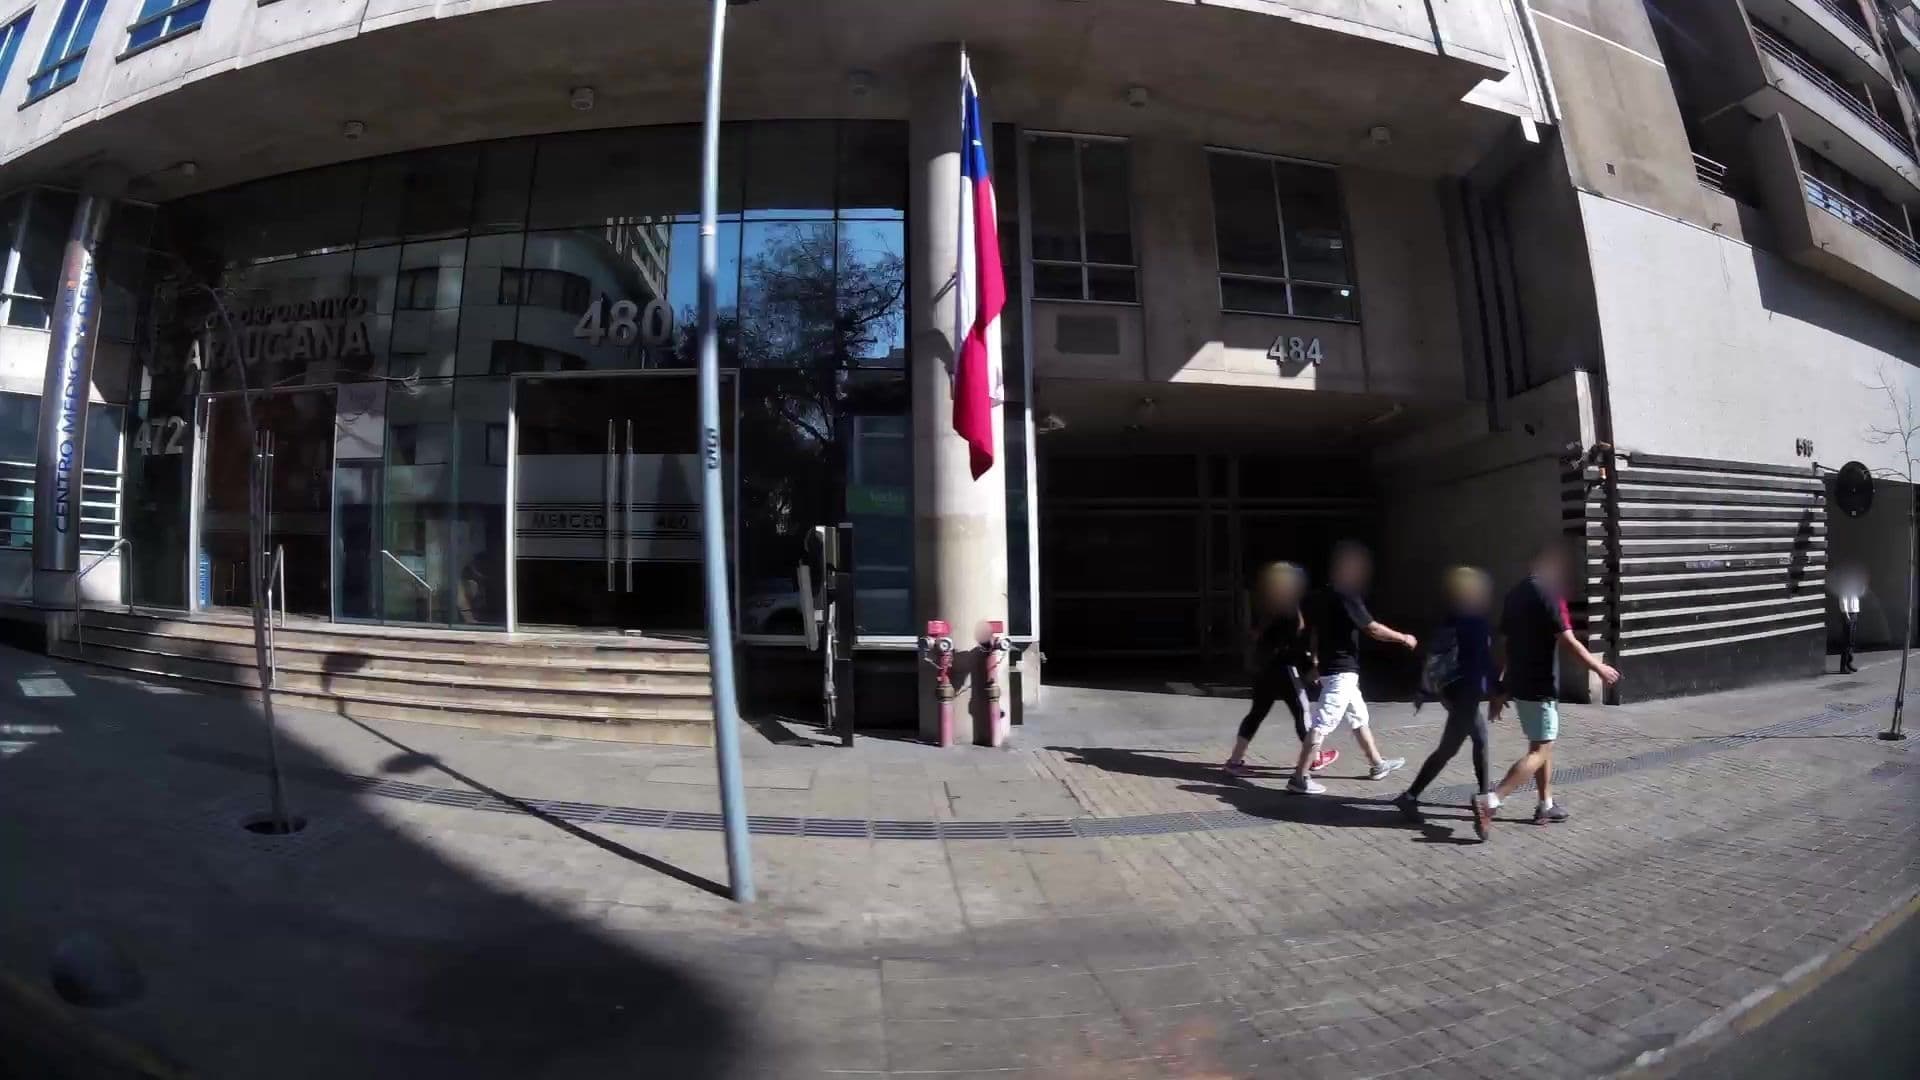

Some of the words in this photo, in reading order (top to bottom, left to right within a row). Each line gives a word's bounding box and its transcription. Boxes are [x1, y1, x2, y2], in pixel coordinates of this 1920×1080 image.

[573, 298, 673, 347] 480
[1267, 335, 1323, 365] 484
[61, 342, 84, 433] MEDICO
[134, 415, 186, 455] 472
[55, 438, 74, 534] CENTRO
